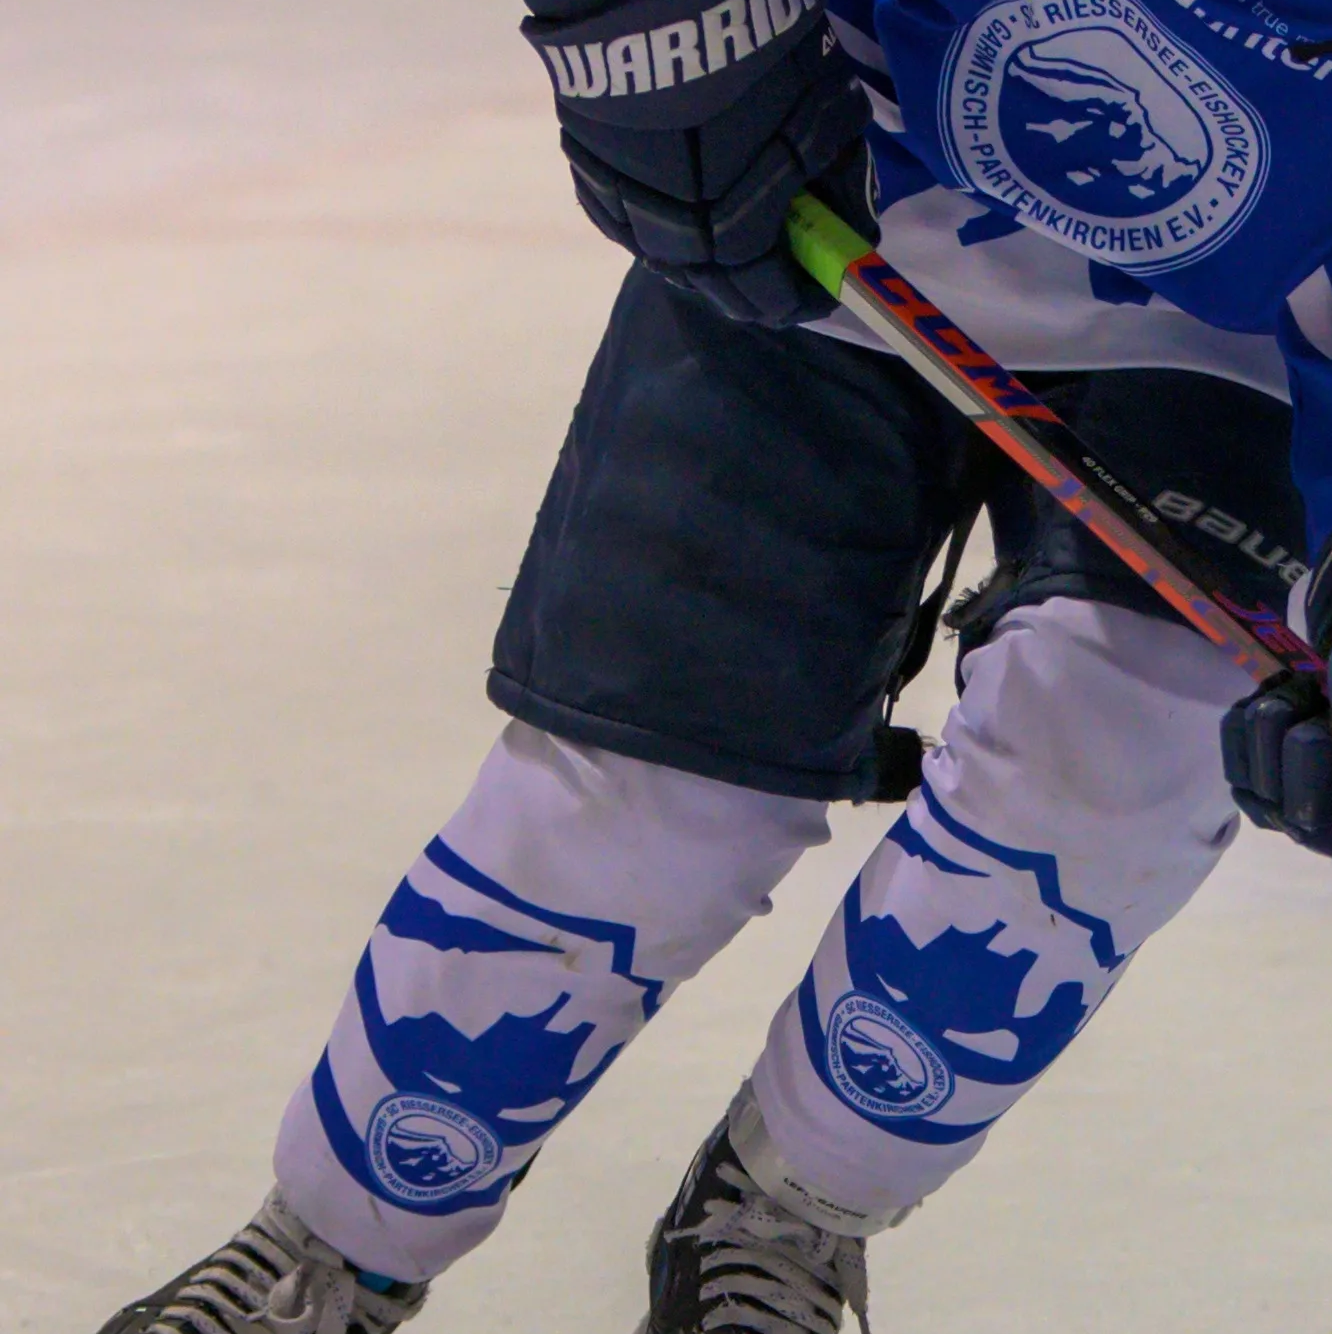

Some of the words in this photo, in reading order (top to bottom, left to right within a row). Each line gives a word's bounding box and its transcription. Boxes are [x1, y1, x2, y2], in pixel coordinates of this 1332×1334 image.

[1250, 0, 1290, 37] true
[961, 17, 1165, 253] GARMISCH-PARTENKIRCHEN
[1093, 465, 1119, 488] FLEX
